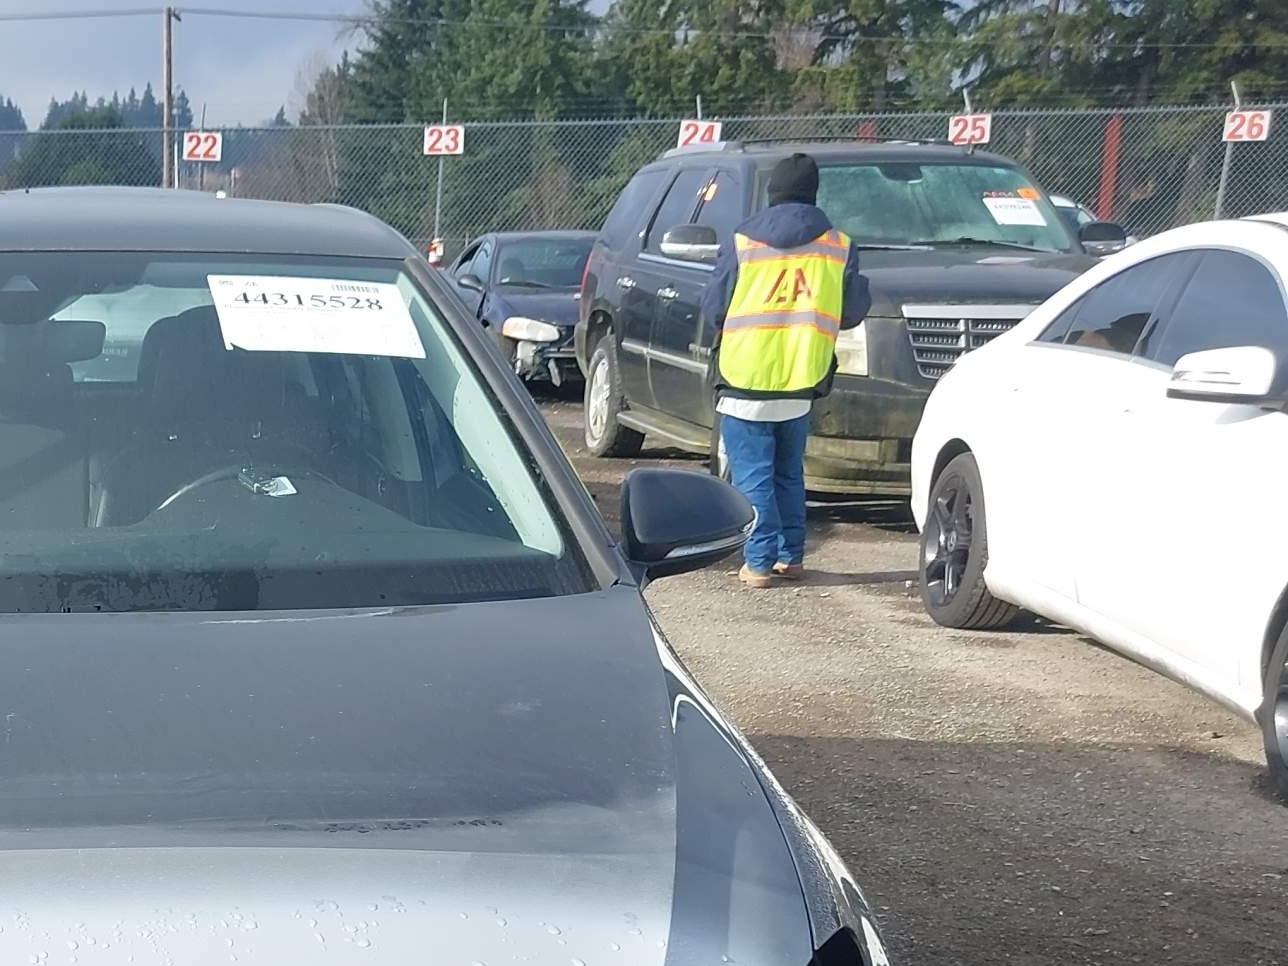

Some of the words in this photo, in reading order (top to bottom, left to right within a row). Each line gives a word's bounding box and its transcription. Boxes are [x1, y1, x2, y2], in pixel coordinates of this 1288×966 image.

[682, 123, 714, 146] 24
[953, 116, 985, 143] 25
[1228, 112, 1265, 139] 26
[188, 134, 217, 158] 22
[428, 128, 458, 152] 23
[234, 292, 383, 311] 44315528
